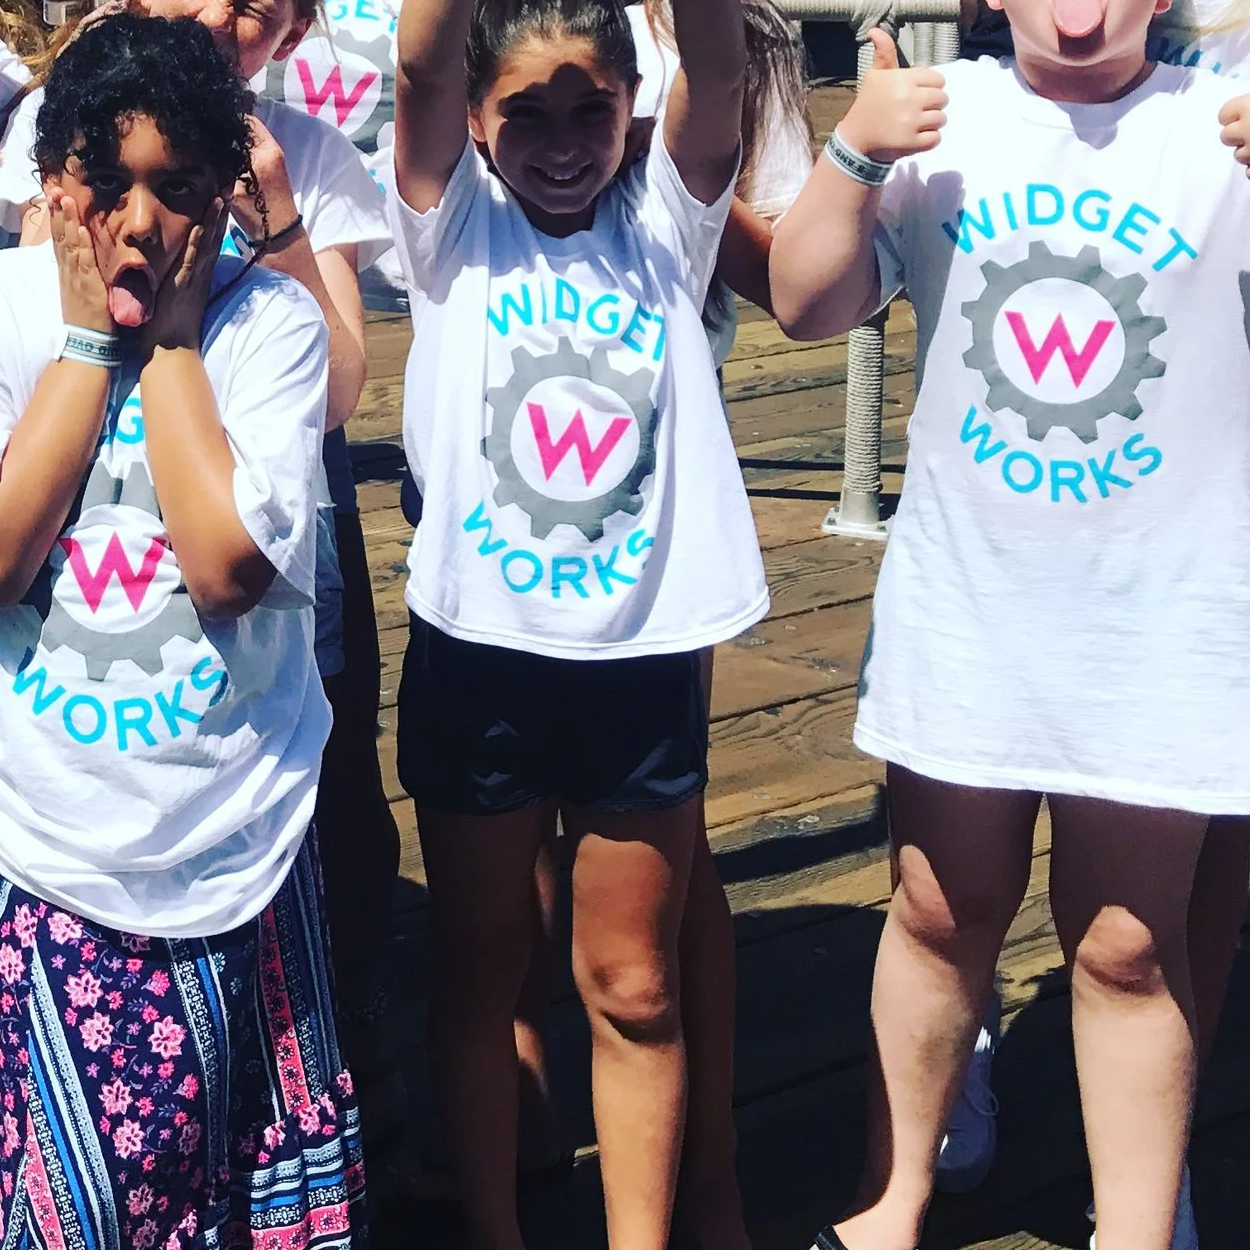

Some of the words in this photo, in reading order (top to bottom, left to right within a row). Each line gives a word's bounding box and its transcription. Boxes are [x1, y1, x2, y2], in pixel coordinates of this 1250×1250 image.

[293, 56, 380, 129] W
[941, 182, 1199, 274] WIDGET
[487, 277, 666, 363] WIDGET
[1002, 310, 1118, 390] W
[525, 401, 634, 488] W
[958, 404, 1164, 504] WORKS
[59, 530, 170, 615] W
[461, 499, 656, 599] WORKS
[11, 645, 230, 752] WORKS
